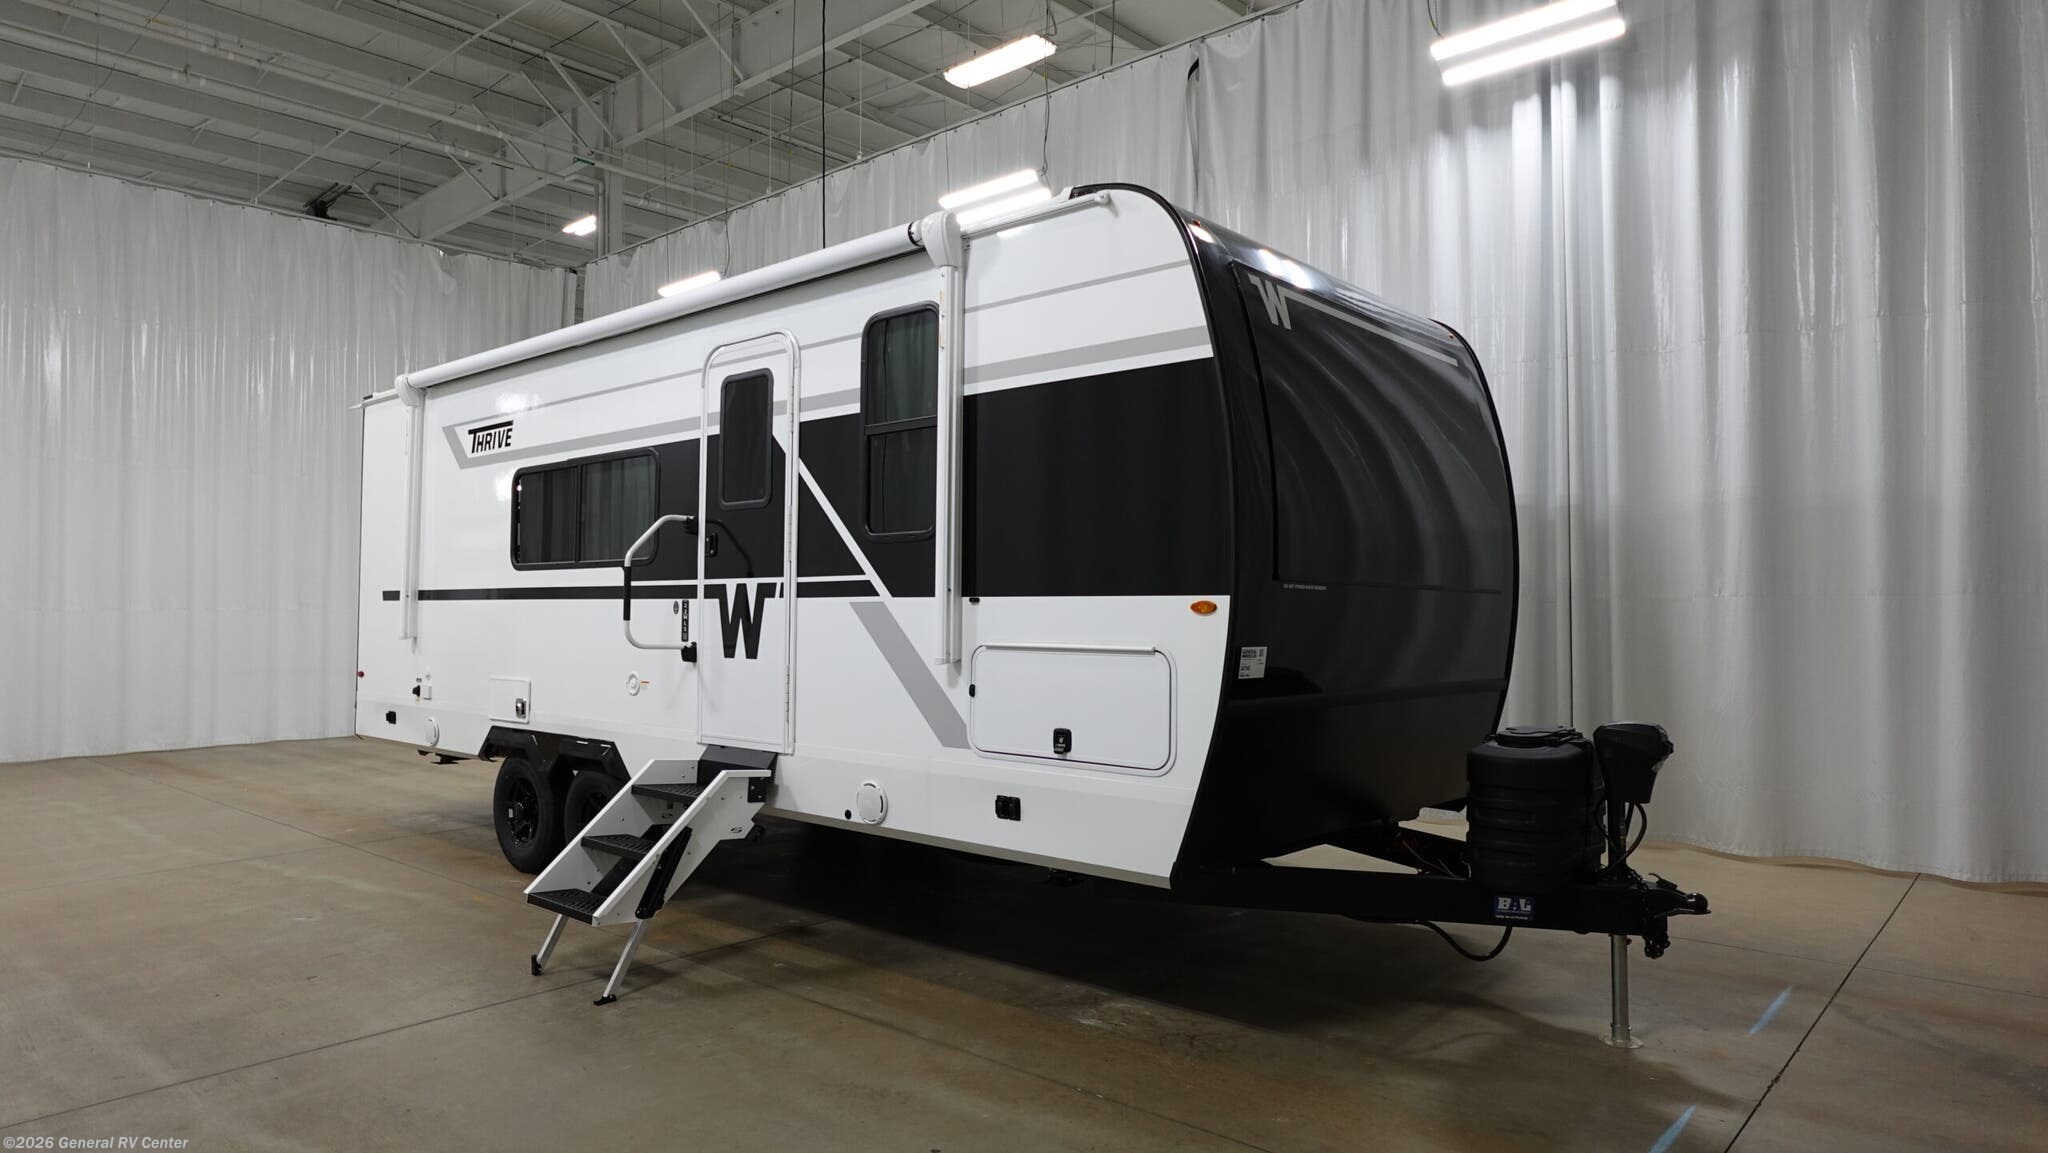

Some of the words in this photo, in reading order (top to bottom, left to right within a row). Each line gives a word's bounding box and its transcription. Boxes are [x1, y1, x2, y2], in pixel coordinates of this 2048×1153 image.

[1247, 273, 1296, 330] W
[467, 419, 514, 454] THRIVE
[706, 582, 778, 660] W
